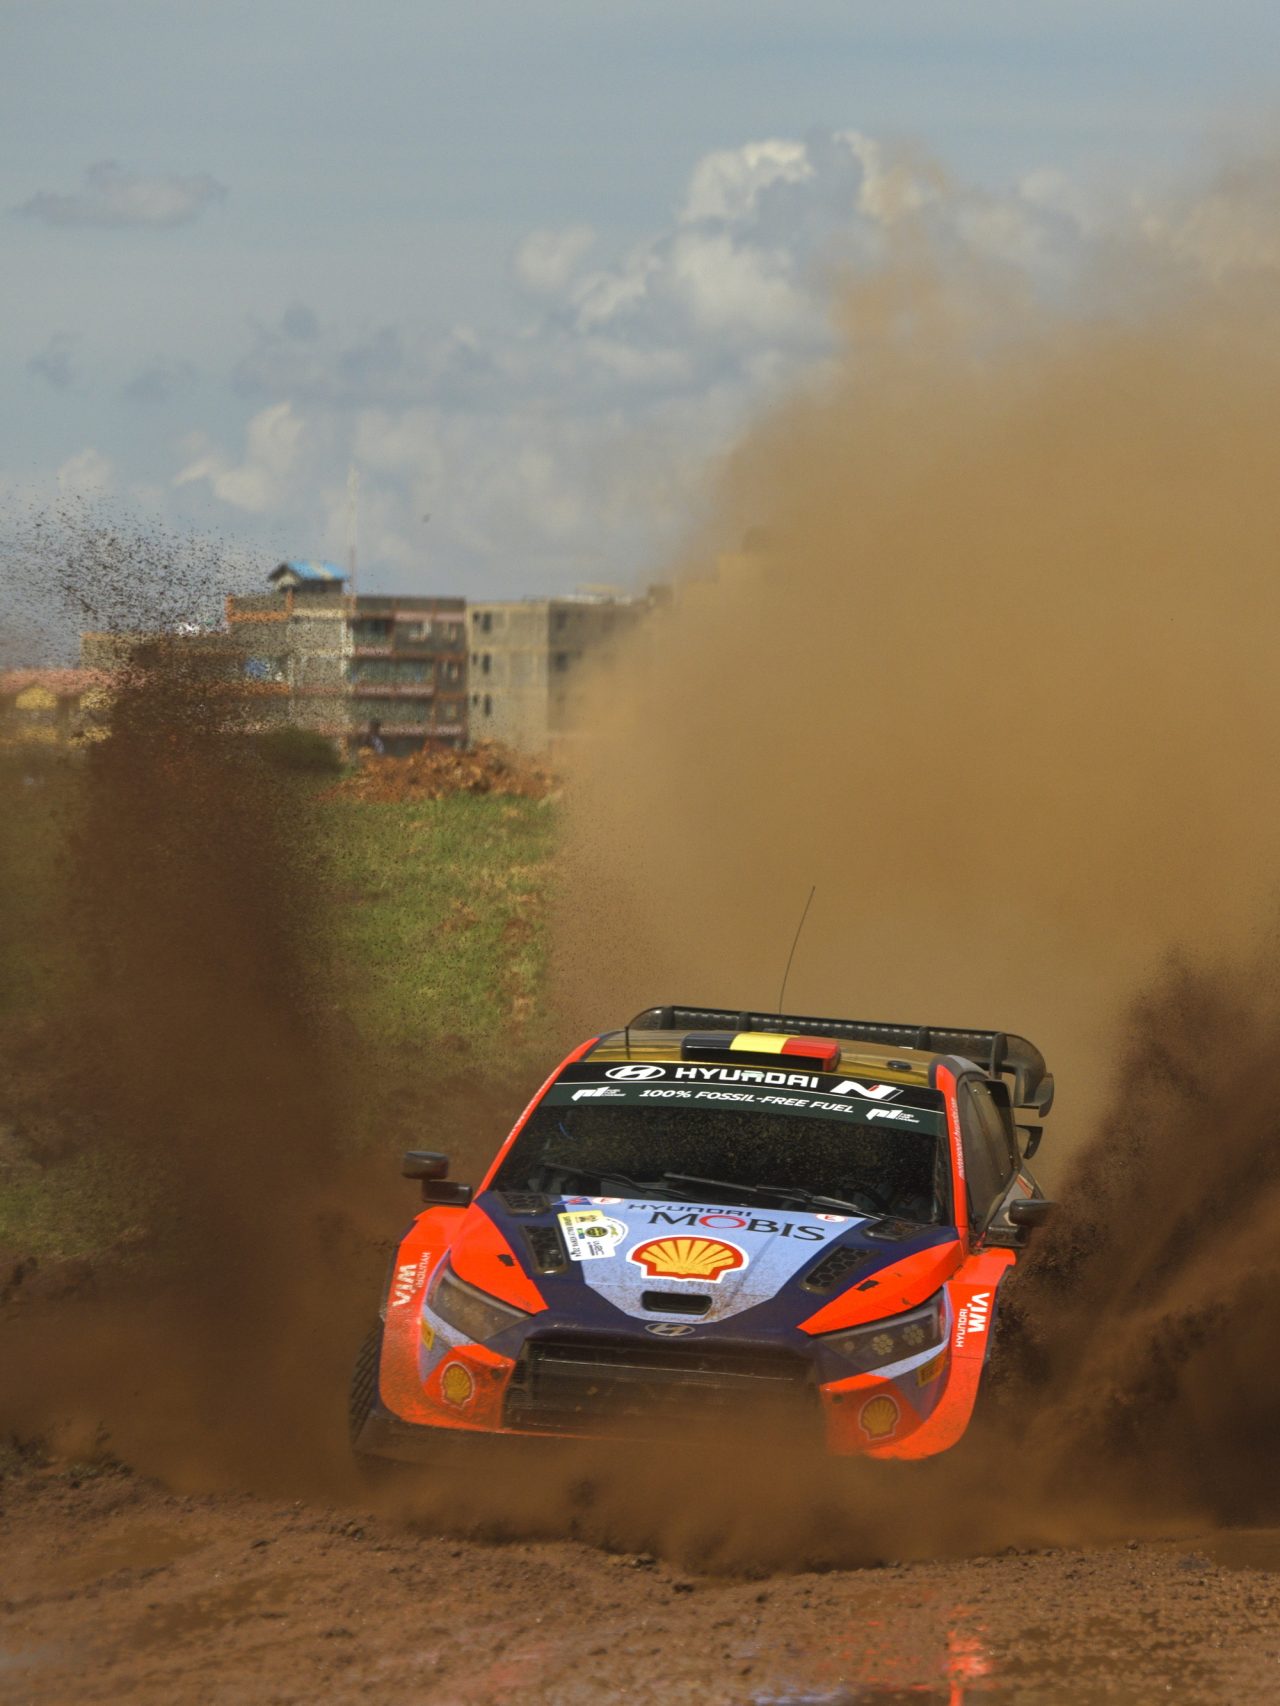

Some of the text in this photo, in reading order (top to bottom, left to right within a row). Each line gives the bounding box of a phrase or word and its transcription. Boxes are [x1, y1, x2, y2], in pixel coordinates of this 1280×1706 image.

[675, 1067, 819, 1088] HYUNDAI
[639, 1089, 692, 1098] 100%
[694, 1091, 810, 1107] FOSSIL-FREE
[810, 1101, 854, 1113] FUEL
[628, 1204, 752, 1217] HYUNDAI
[647, 1211, 826, 1241] MOBIS
[955, 1308, 968, 1348] HYUNDAI
